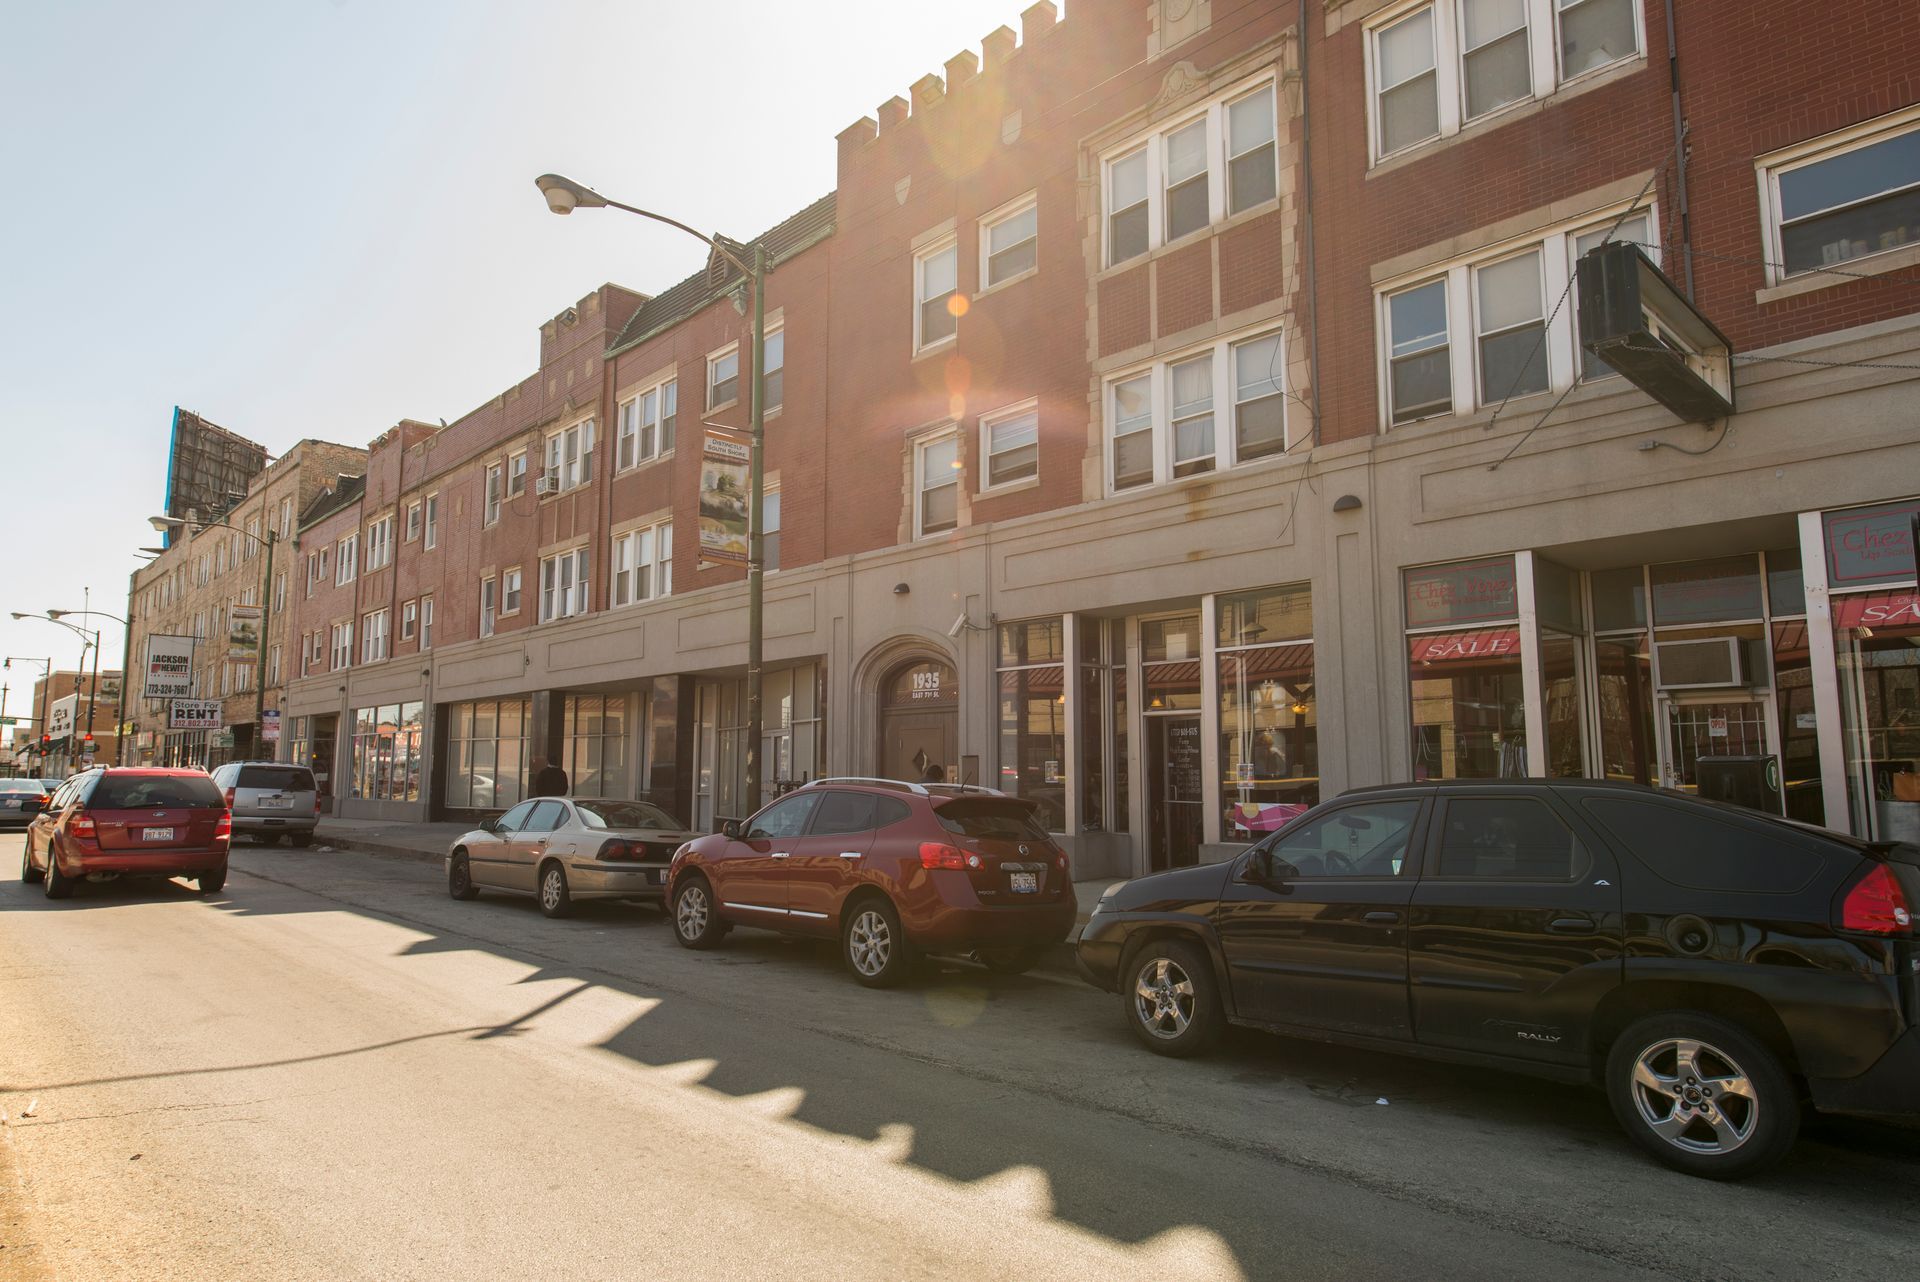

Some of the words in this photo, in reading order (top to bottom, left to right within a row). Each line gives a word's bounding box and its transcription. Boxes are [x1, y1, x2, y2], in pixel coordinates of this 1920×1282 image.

[1843, 526, 1911, 552] Chez
[1426, 638, 1511, 657] SALE
[152, 654, 189, 665] JACKSON
[161, 664, 188, 673] HEWITT
[912, 671, 940, 689] 1935
[175, 709, 218, 719] RENT
[1711, 719, 1727, 729] OPEN
[1517, 1031, 1561, 1043] RALLY
